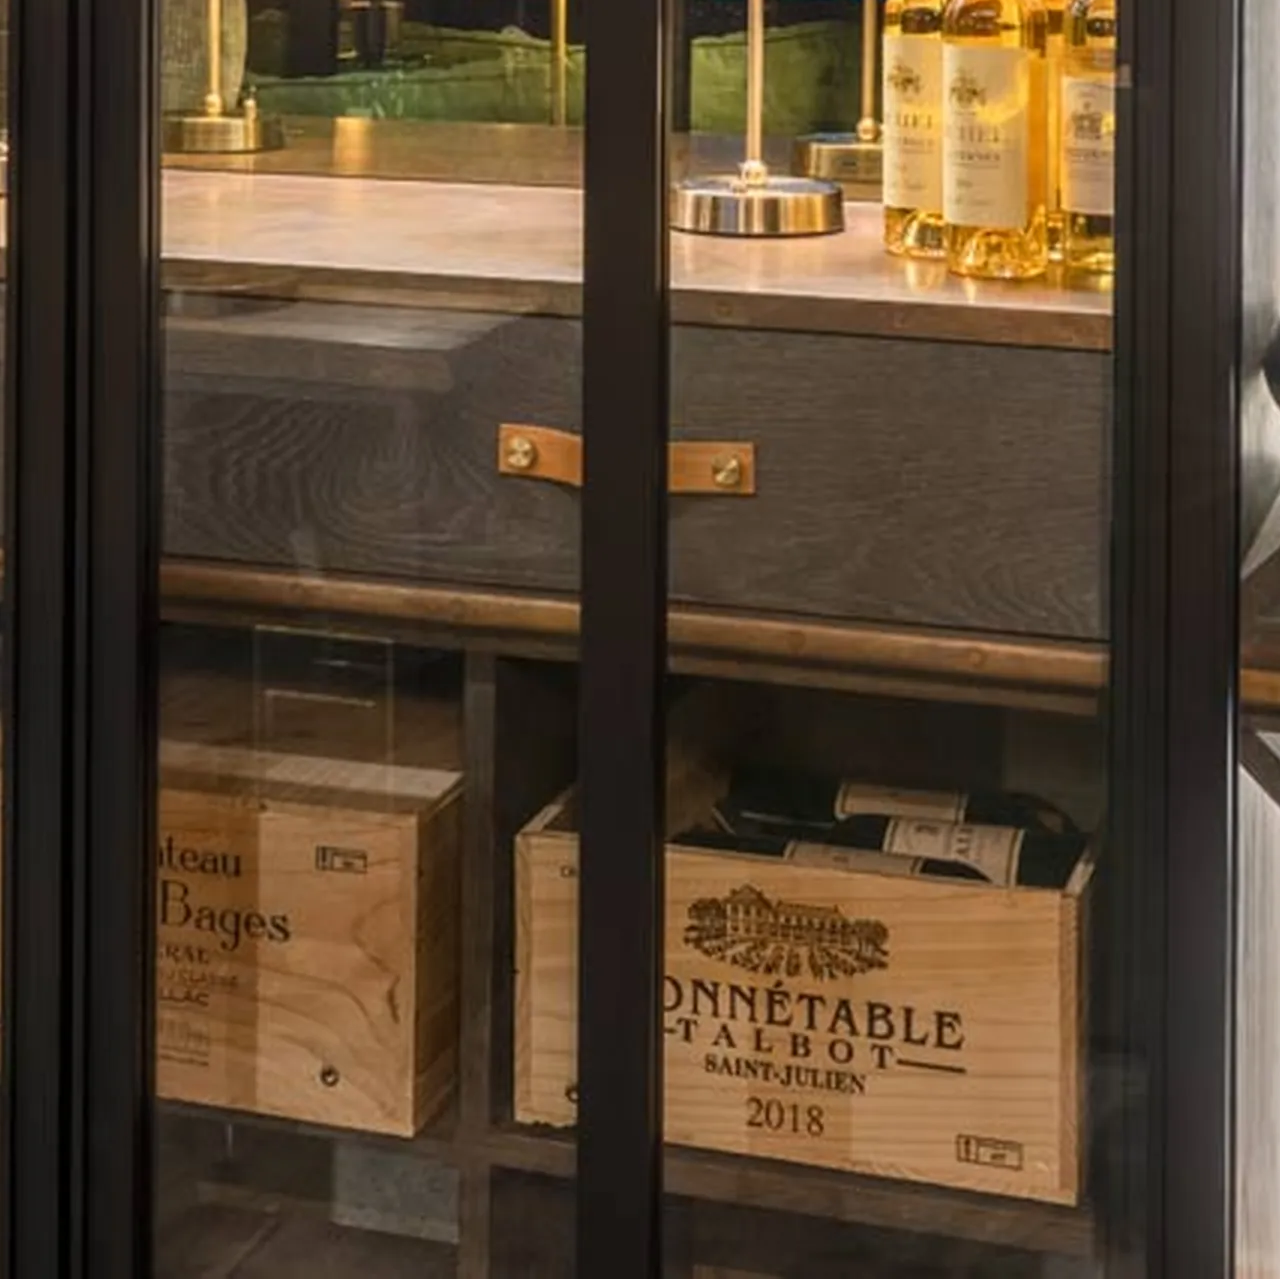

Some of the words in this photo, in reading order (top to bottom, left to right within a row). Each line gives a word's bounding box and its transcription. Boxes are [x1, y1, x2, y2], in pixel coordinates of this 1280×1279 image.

[161, 879, 292, 952] Bages
[677, 1017, 894, 1070] TALBOT
[704, 1053, 867, 1095] SAINT-JULIEN
[746, 1097, 825, 1137] 2018
